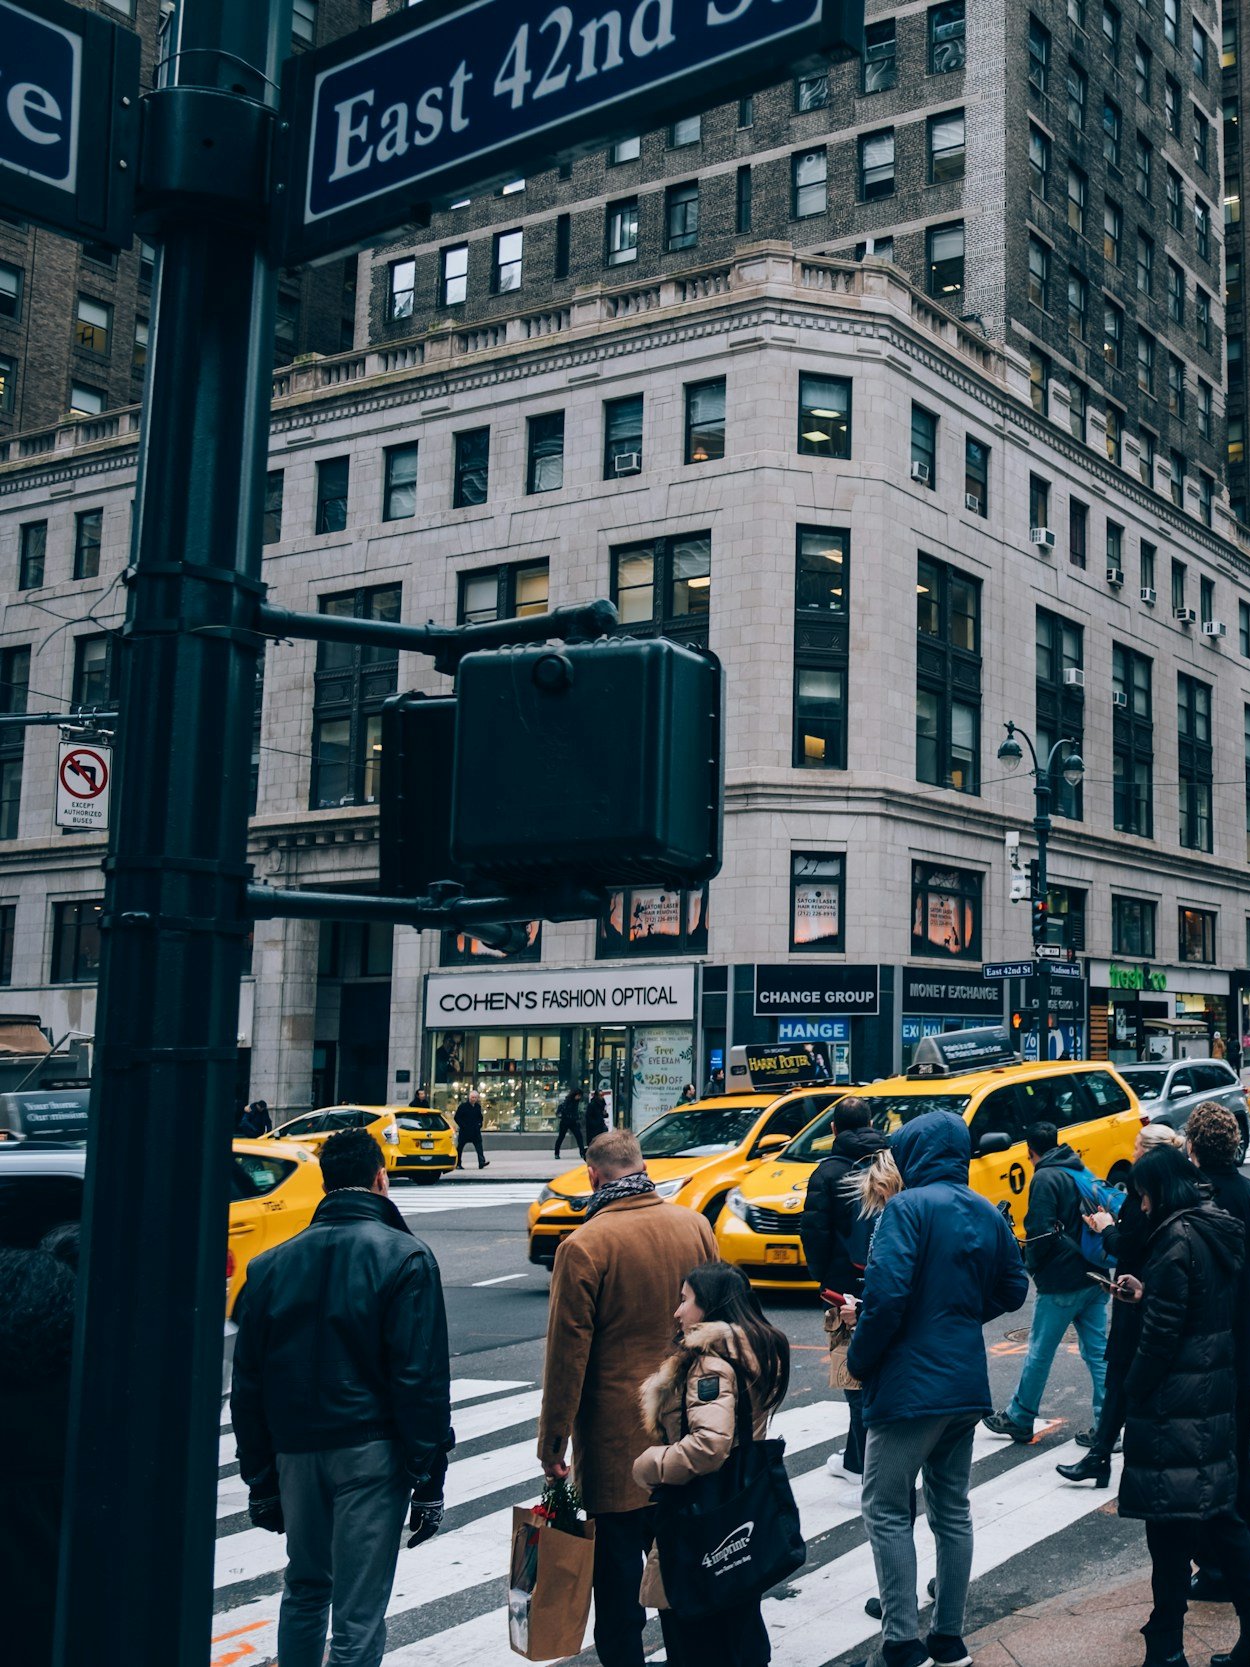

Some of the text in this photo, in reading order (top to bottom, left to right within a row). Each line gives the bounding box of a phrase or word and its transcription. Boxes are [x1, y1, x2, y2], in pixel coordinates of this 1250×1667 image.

[328, 0, 677, 184] East 42nd
[0, 76, 63, 146] e
[71, 801, 95, 809] EXCEPT
[64, 809, 103, 818] AUTHORIZED
[986, 965, 1031, 976] East 42nd St
[1050, 965, 1079, 976] Madison Ave
[759, 991, 875, 1003] CHANGE GROUP
[909, 983, 999, 1000] MONEY EXCHANGE
[1049, 986, 1063, 996] THE
[439, 986, 678, 1012] COHEN'S FASHION OPTICAL
[779, 1024, 844, 1038] HANGE
[648, 1057, 680, 1065] EYE EXAM
[748, 1056, 777, 1071] HARRY
[779, 1055, 811, 1068] POTTER
[645, 1074, 683, 1085] $250 OFF
[702, 1536, 750, 1569] 4imprint
